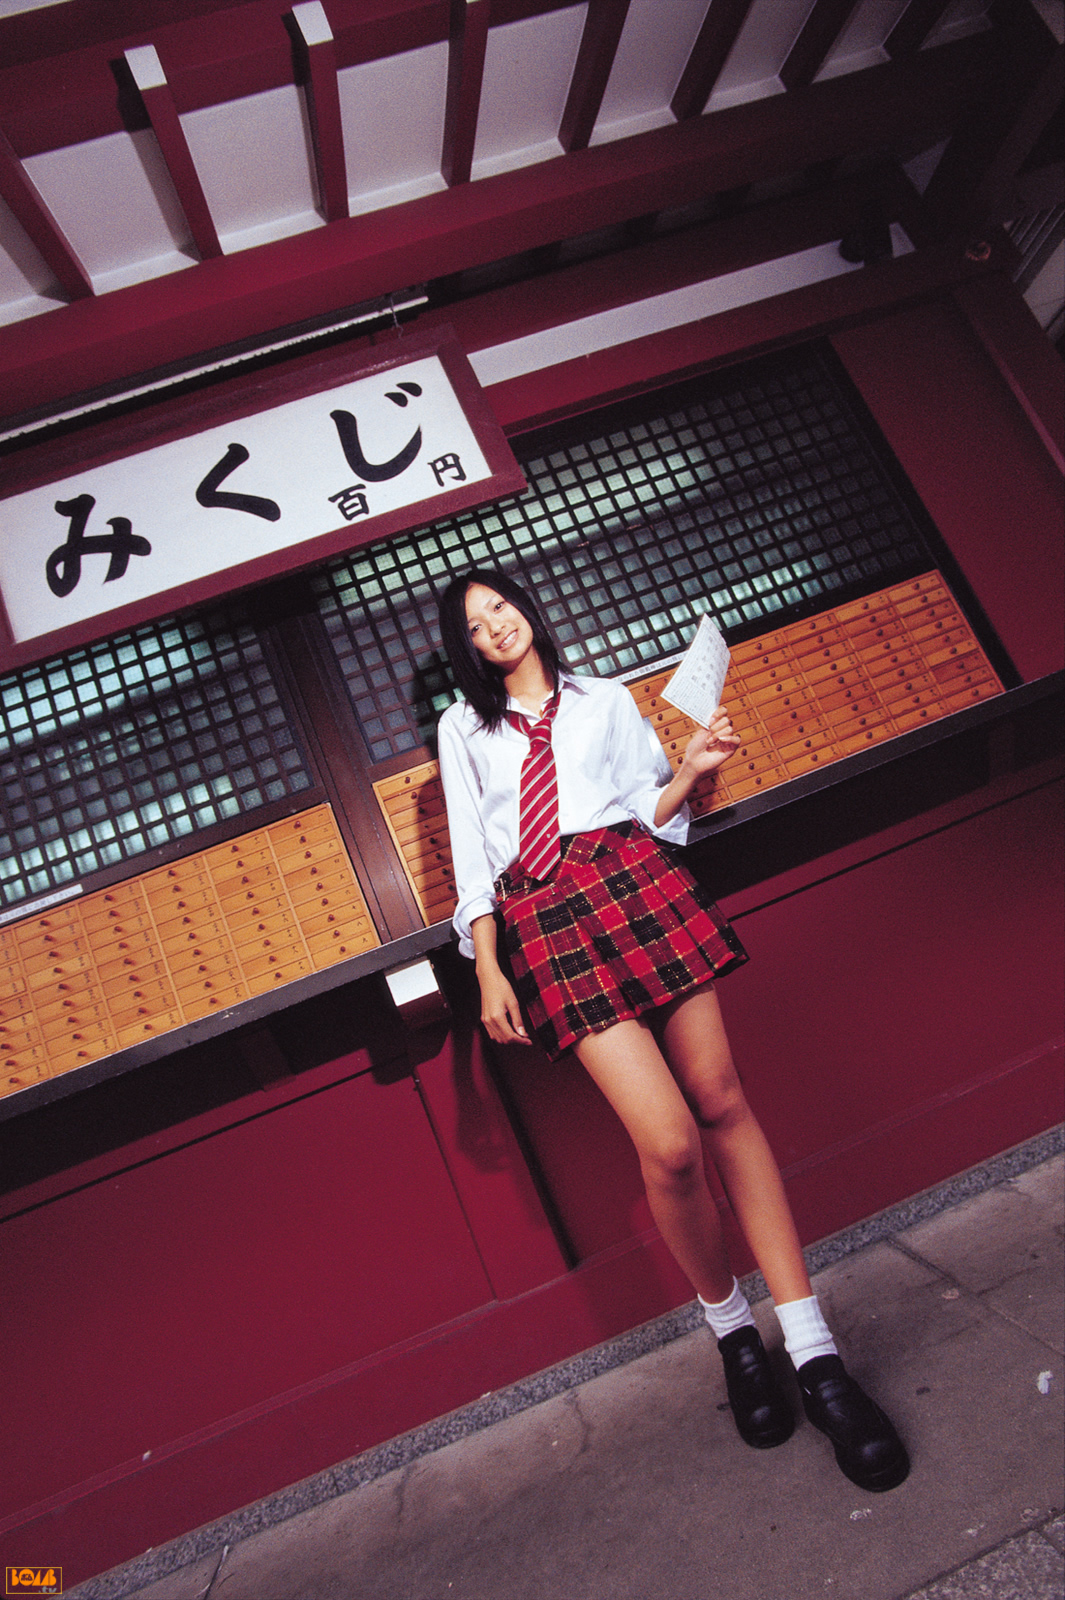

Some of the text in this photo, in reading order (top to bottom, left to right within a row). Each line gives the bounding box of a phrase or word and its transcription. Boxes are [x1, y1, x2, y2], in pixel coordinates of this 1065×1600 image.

[46, 382, 422, 597] みくじ
[329, 453, 466, 521] 百円
